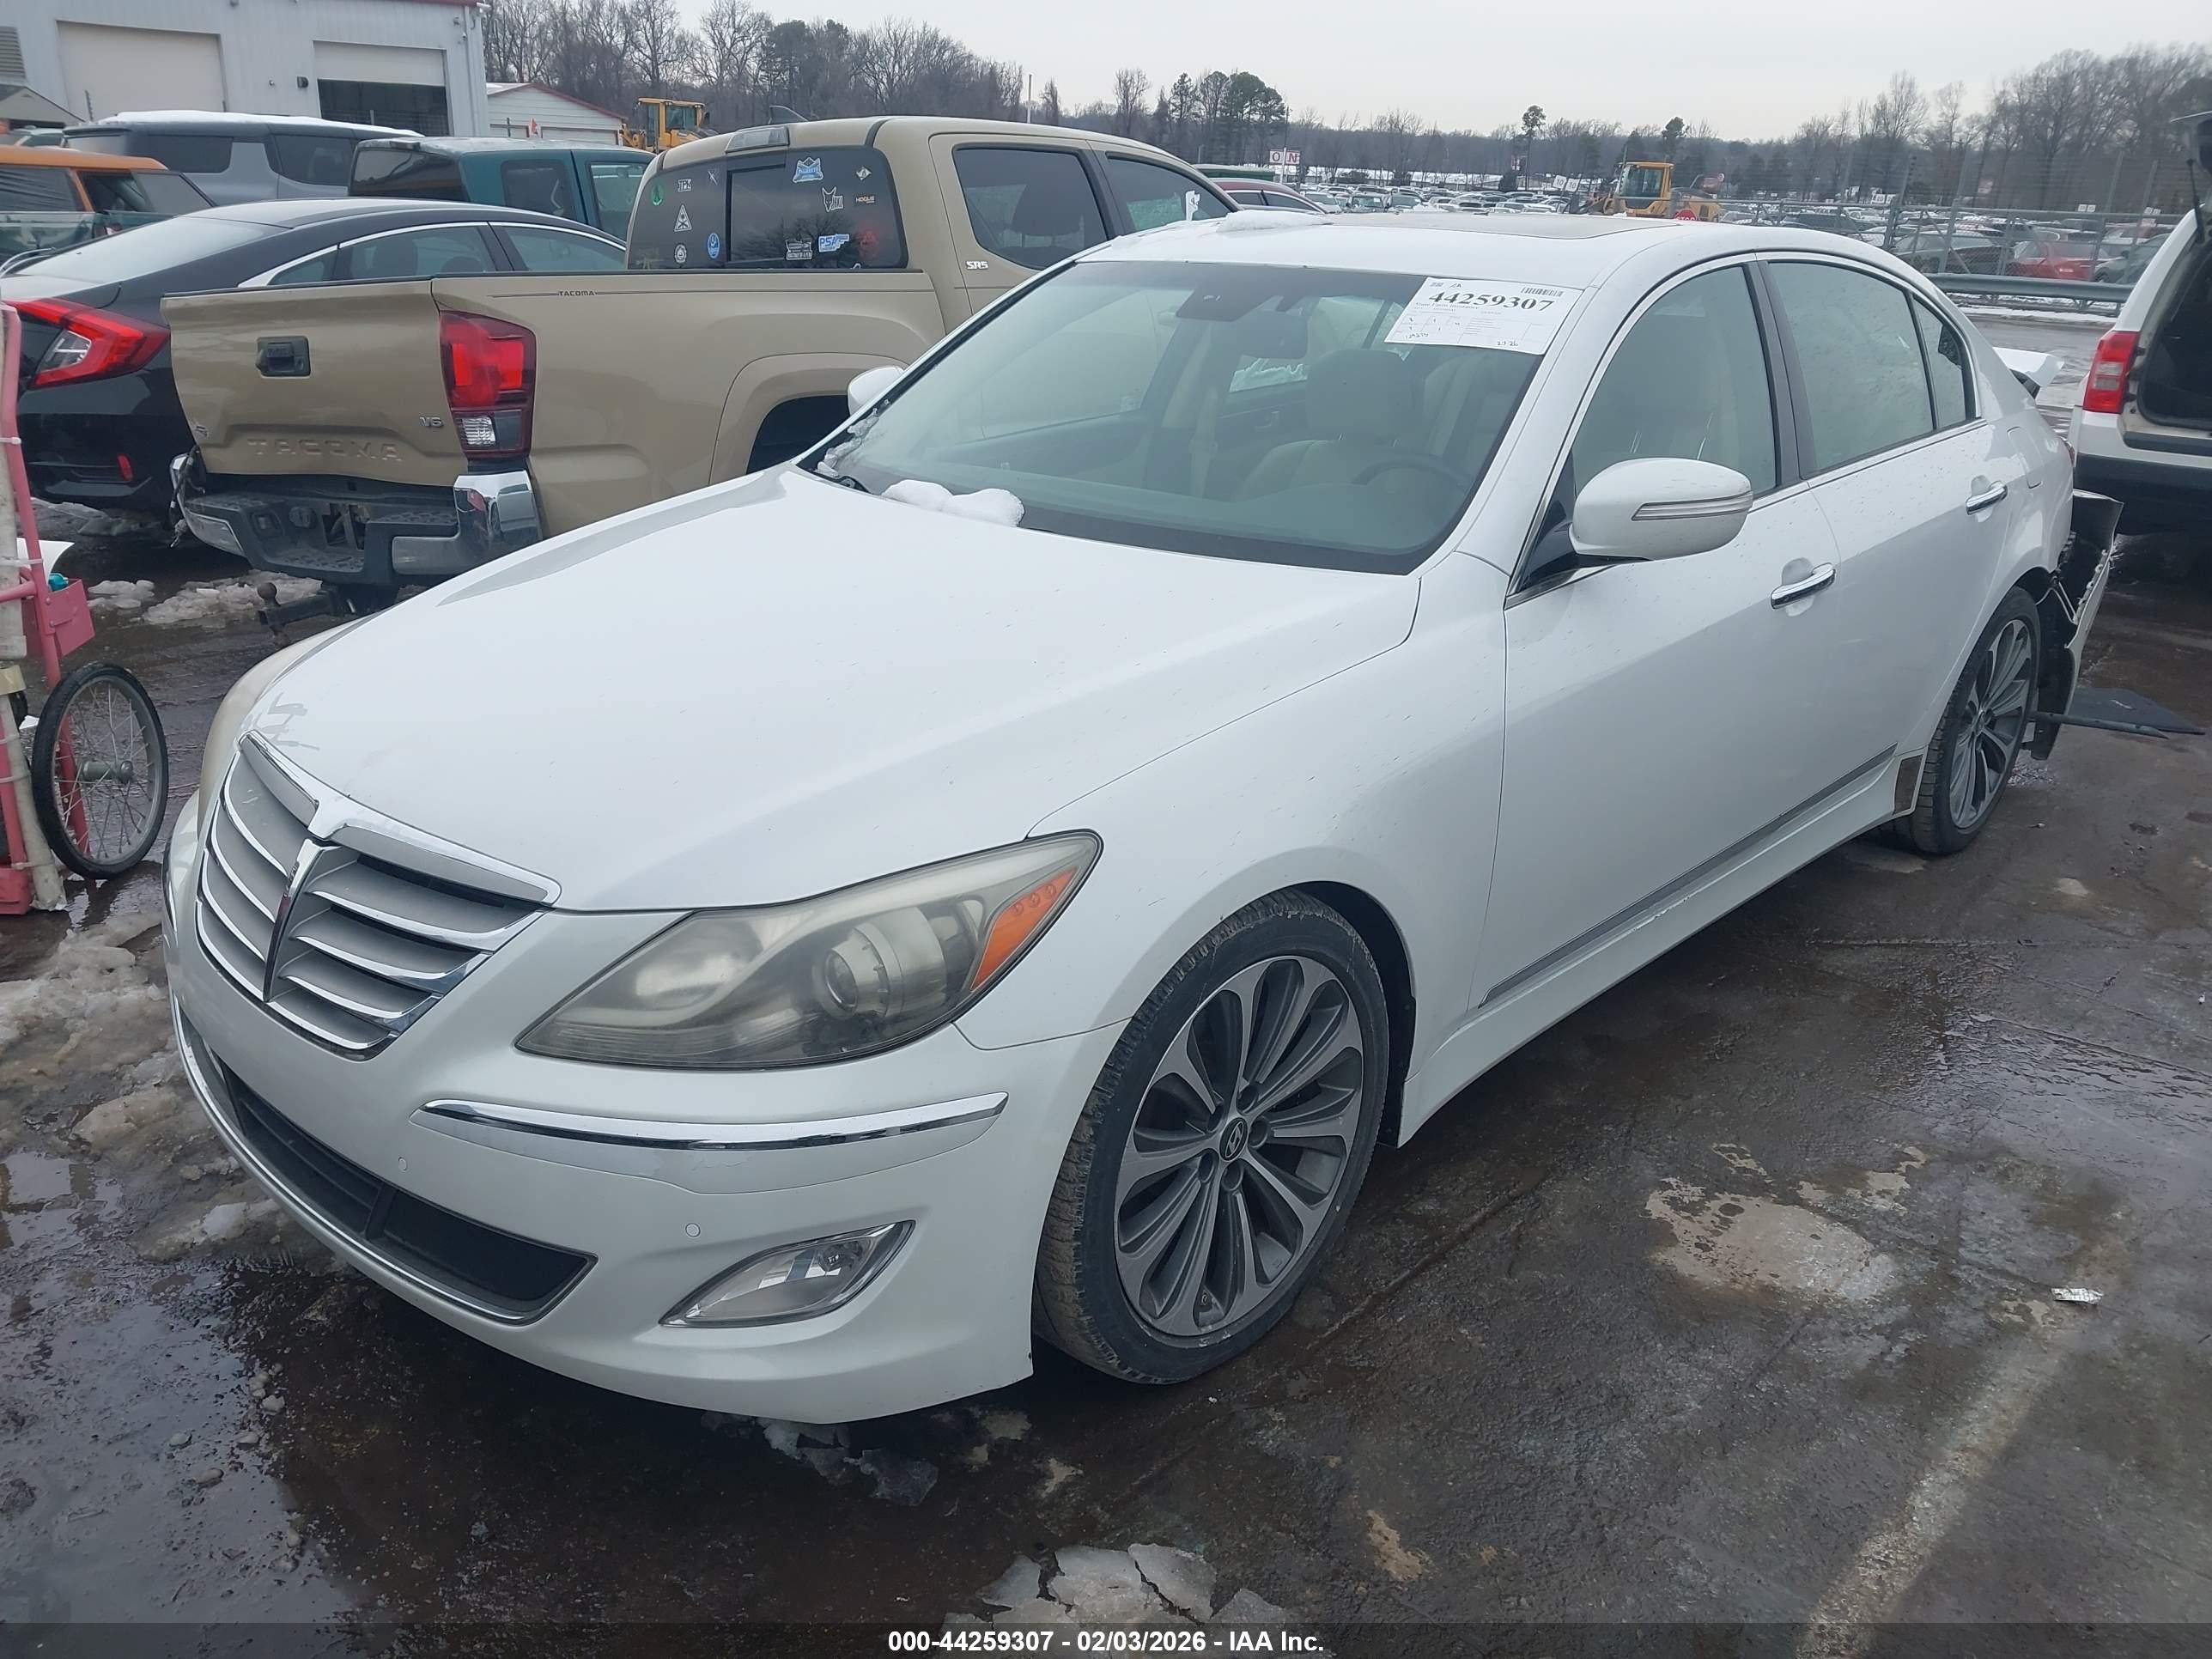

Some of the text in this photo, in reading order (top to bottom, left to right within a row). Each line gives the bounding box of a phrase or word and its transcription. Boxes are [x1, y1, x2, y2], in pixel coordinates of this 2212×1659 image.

[1428, 292, 1555, 311] 44259307
[419, 416, 442, 427] V6
[246, 439, 403, 462] TACOMA
